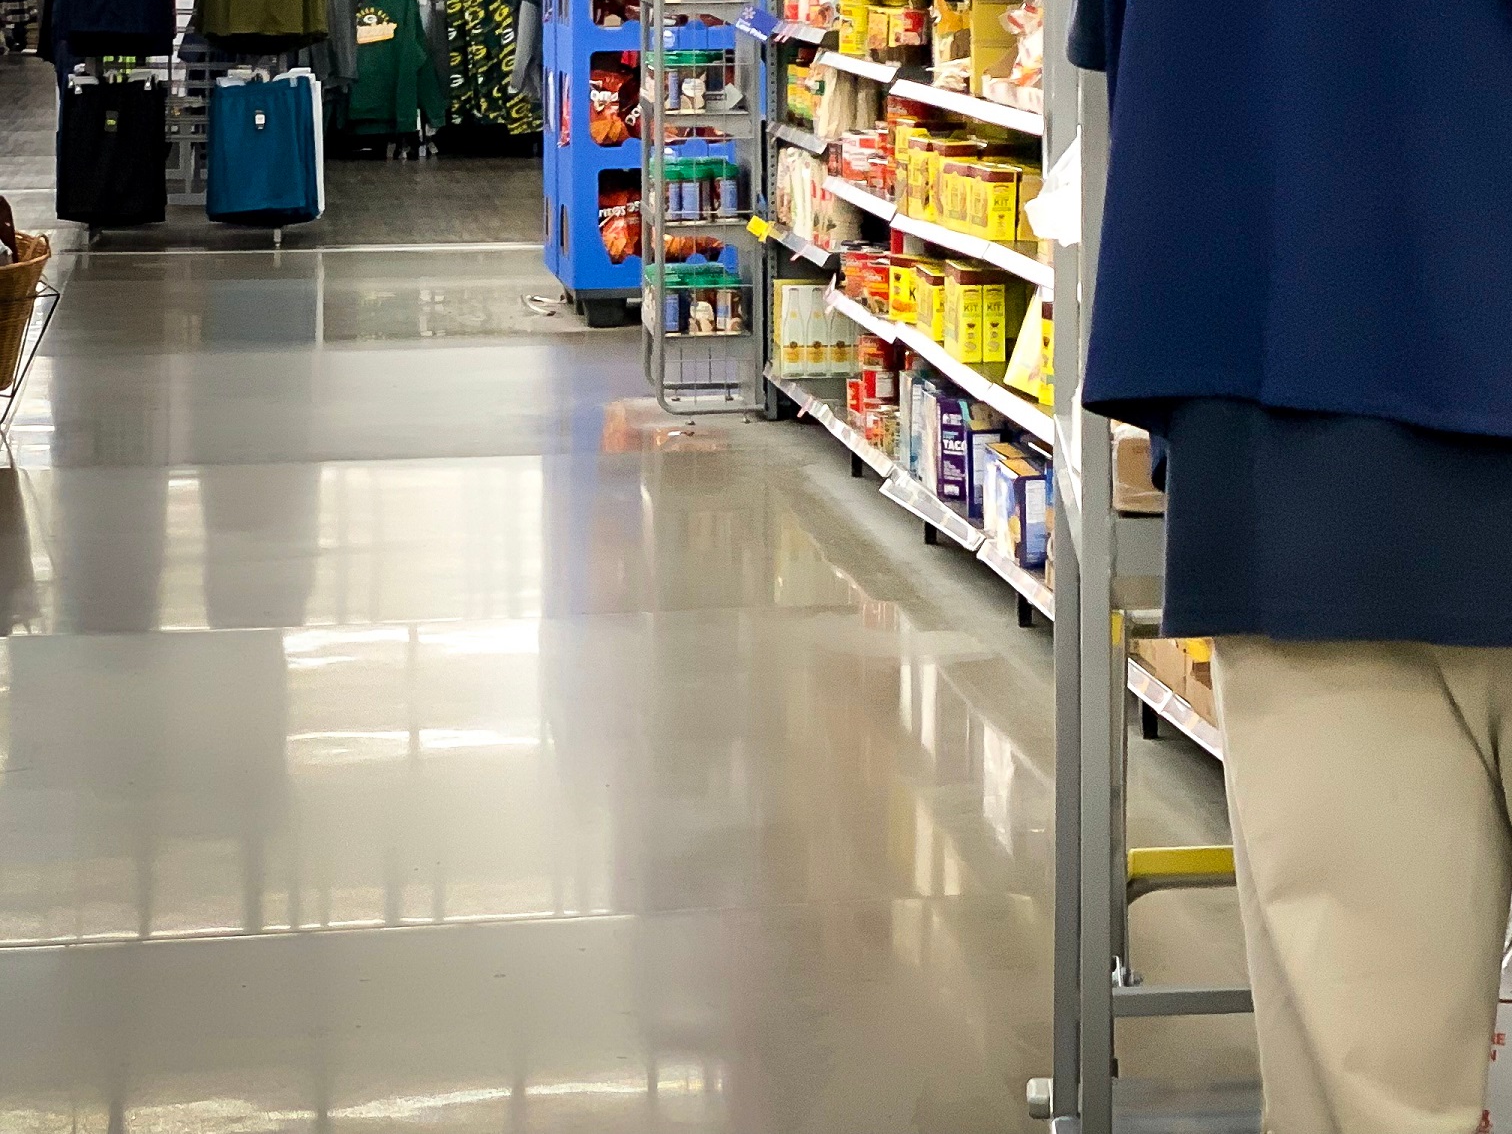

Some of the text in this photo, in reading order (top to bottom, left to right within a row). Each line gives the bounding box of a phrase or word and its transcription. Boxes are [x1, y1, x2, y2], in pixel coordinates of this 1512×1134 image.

[993, 197, 1010, 206] KIT
[963, 304, 979, 312] KIT
[987, 304, 1003, 312] KIT
